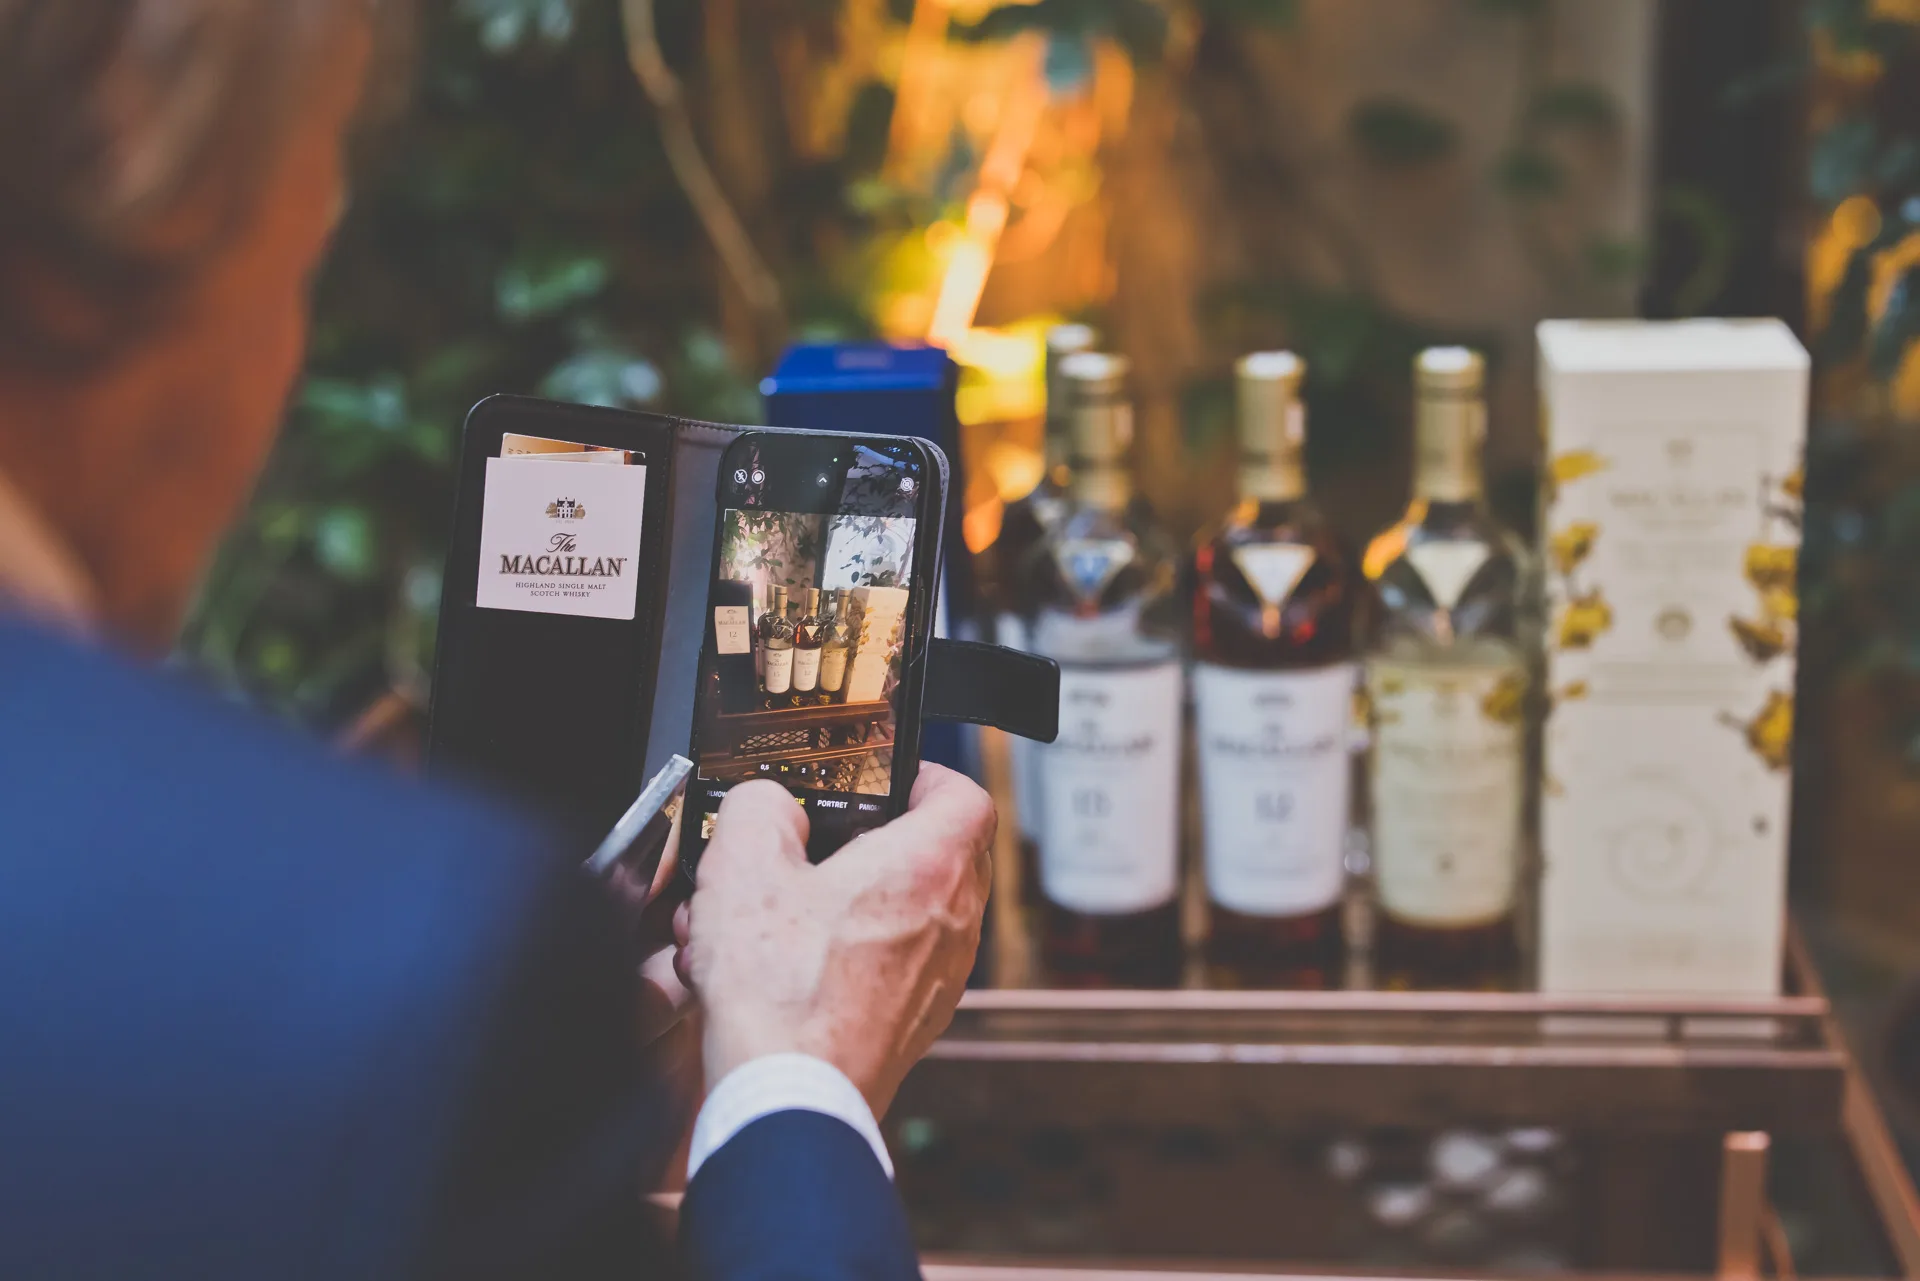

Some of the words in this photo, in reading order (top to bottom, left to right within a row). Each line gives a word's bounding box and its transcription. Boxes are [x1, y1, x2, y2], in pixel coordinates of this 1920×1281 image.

[546, 532, 577, 553] The
[499, 553, 625, 577] MACALLAN
[515, 581, 556, 589] HIGHLAND
[817, 799, 848, 809] PORTRET
